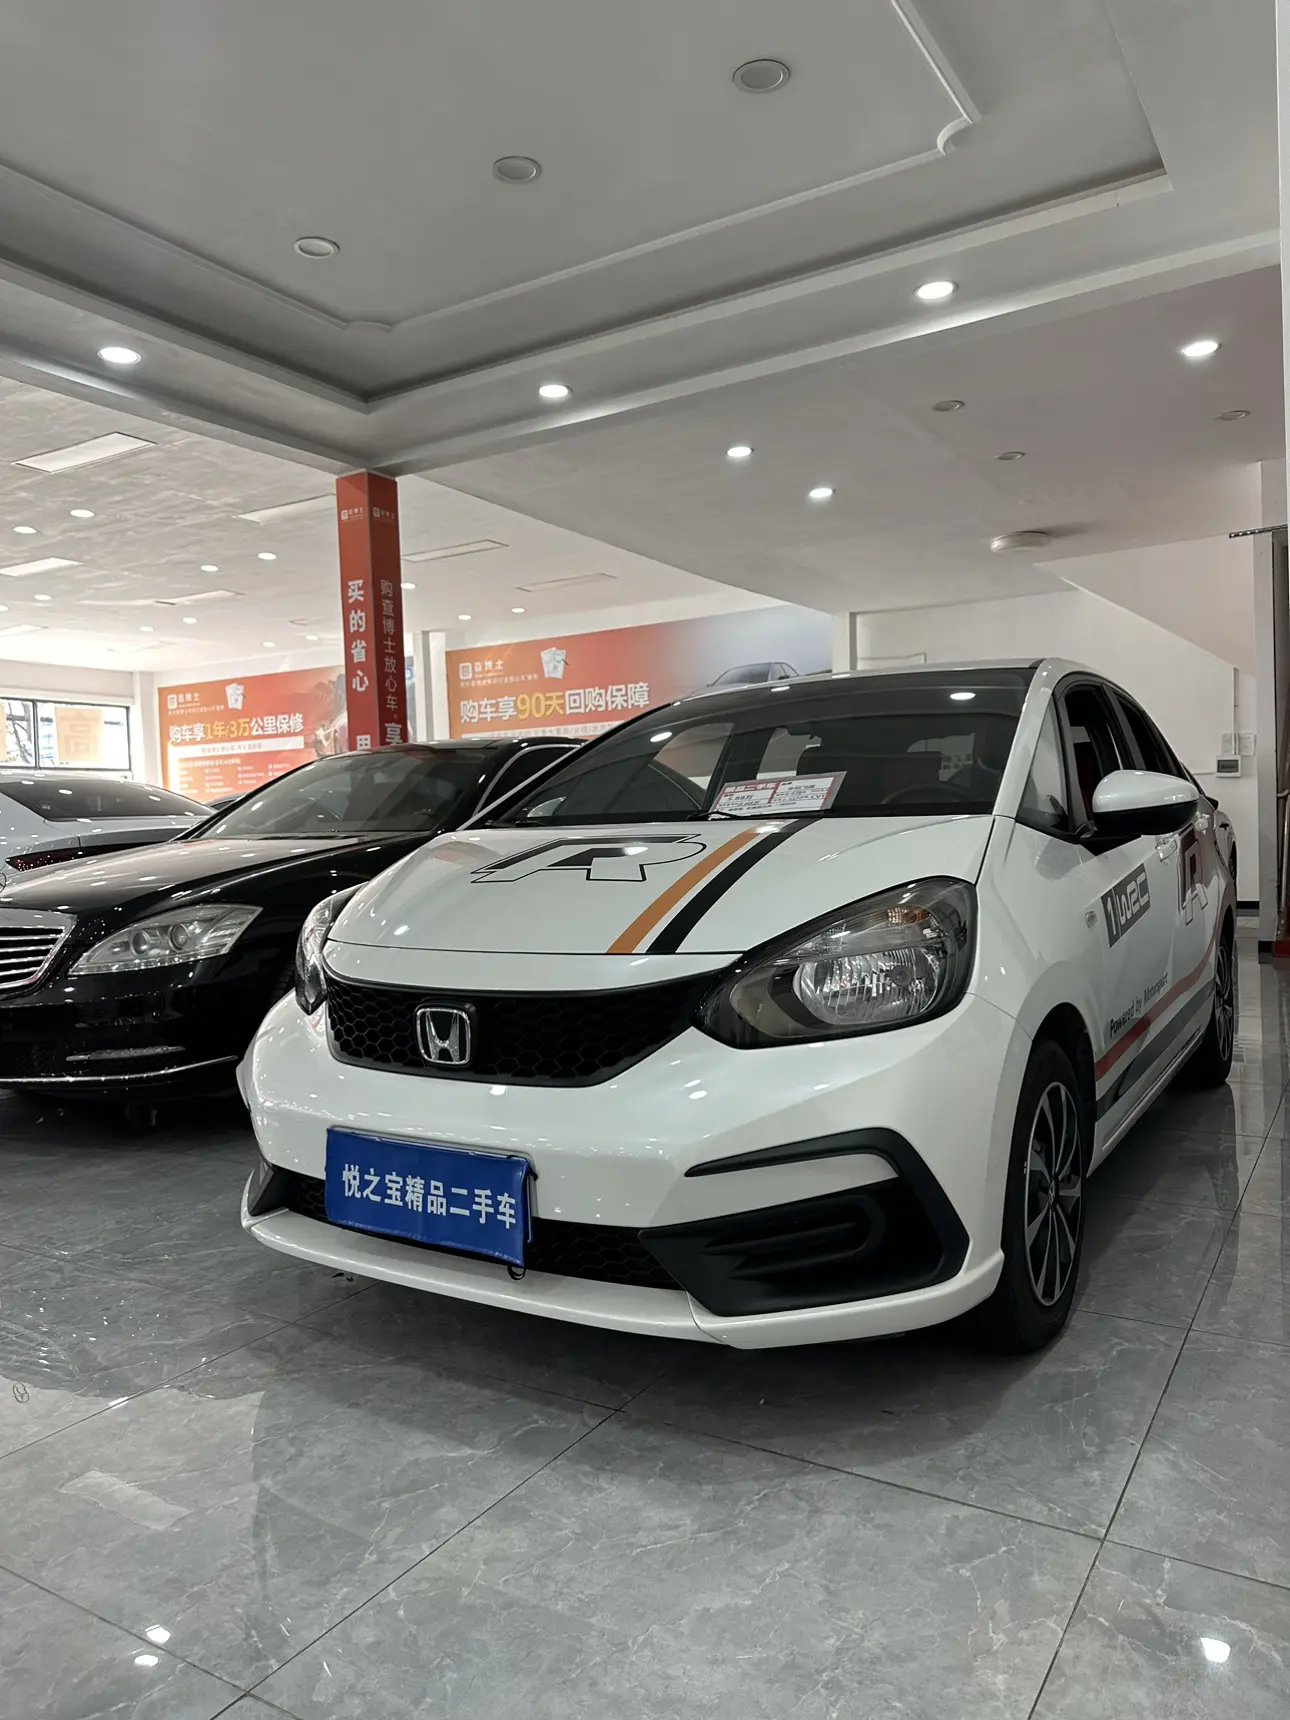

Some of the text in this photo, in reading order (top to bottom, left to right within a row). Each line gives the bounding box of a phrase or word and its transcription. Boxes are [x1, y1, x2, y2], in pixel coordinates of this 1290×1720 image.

[347, 579, 369, 692] 买的省心
[169, 712, 305, 744] 购车享1年/3万公里保修
[460, 681, 650, 724] 购车享90天回购保障
[1106, 896, 1117, 935] 1
[1110, 972, 1168, 1038] Powered by Motorsport
[342, 1163, 517, 1230] 悦之宝精品二手车
